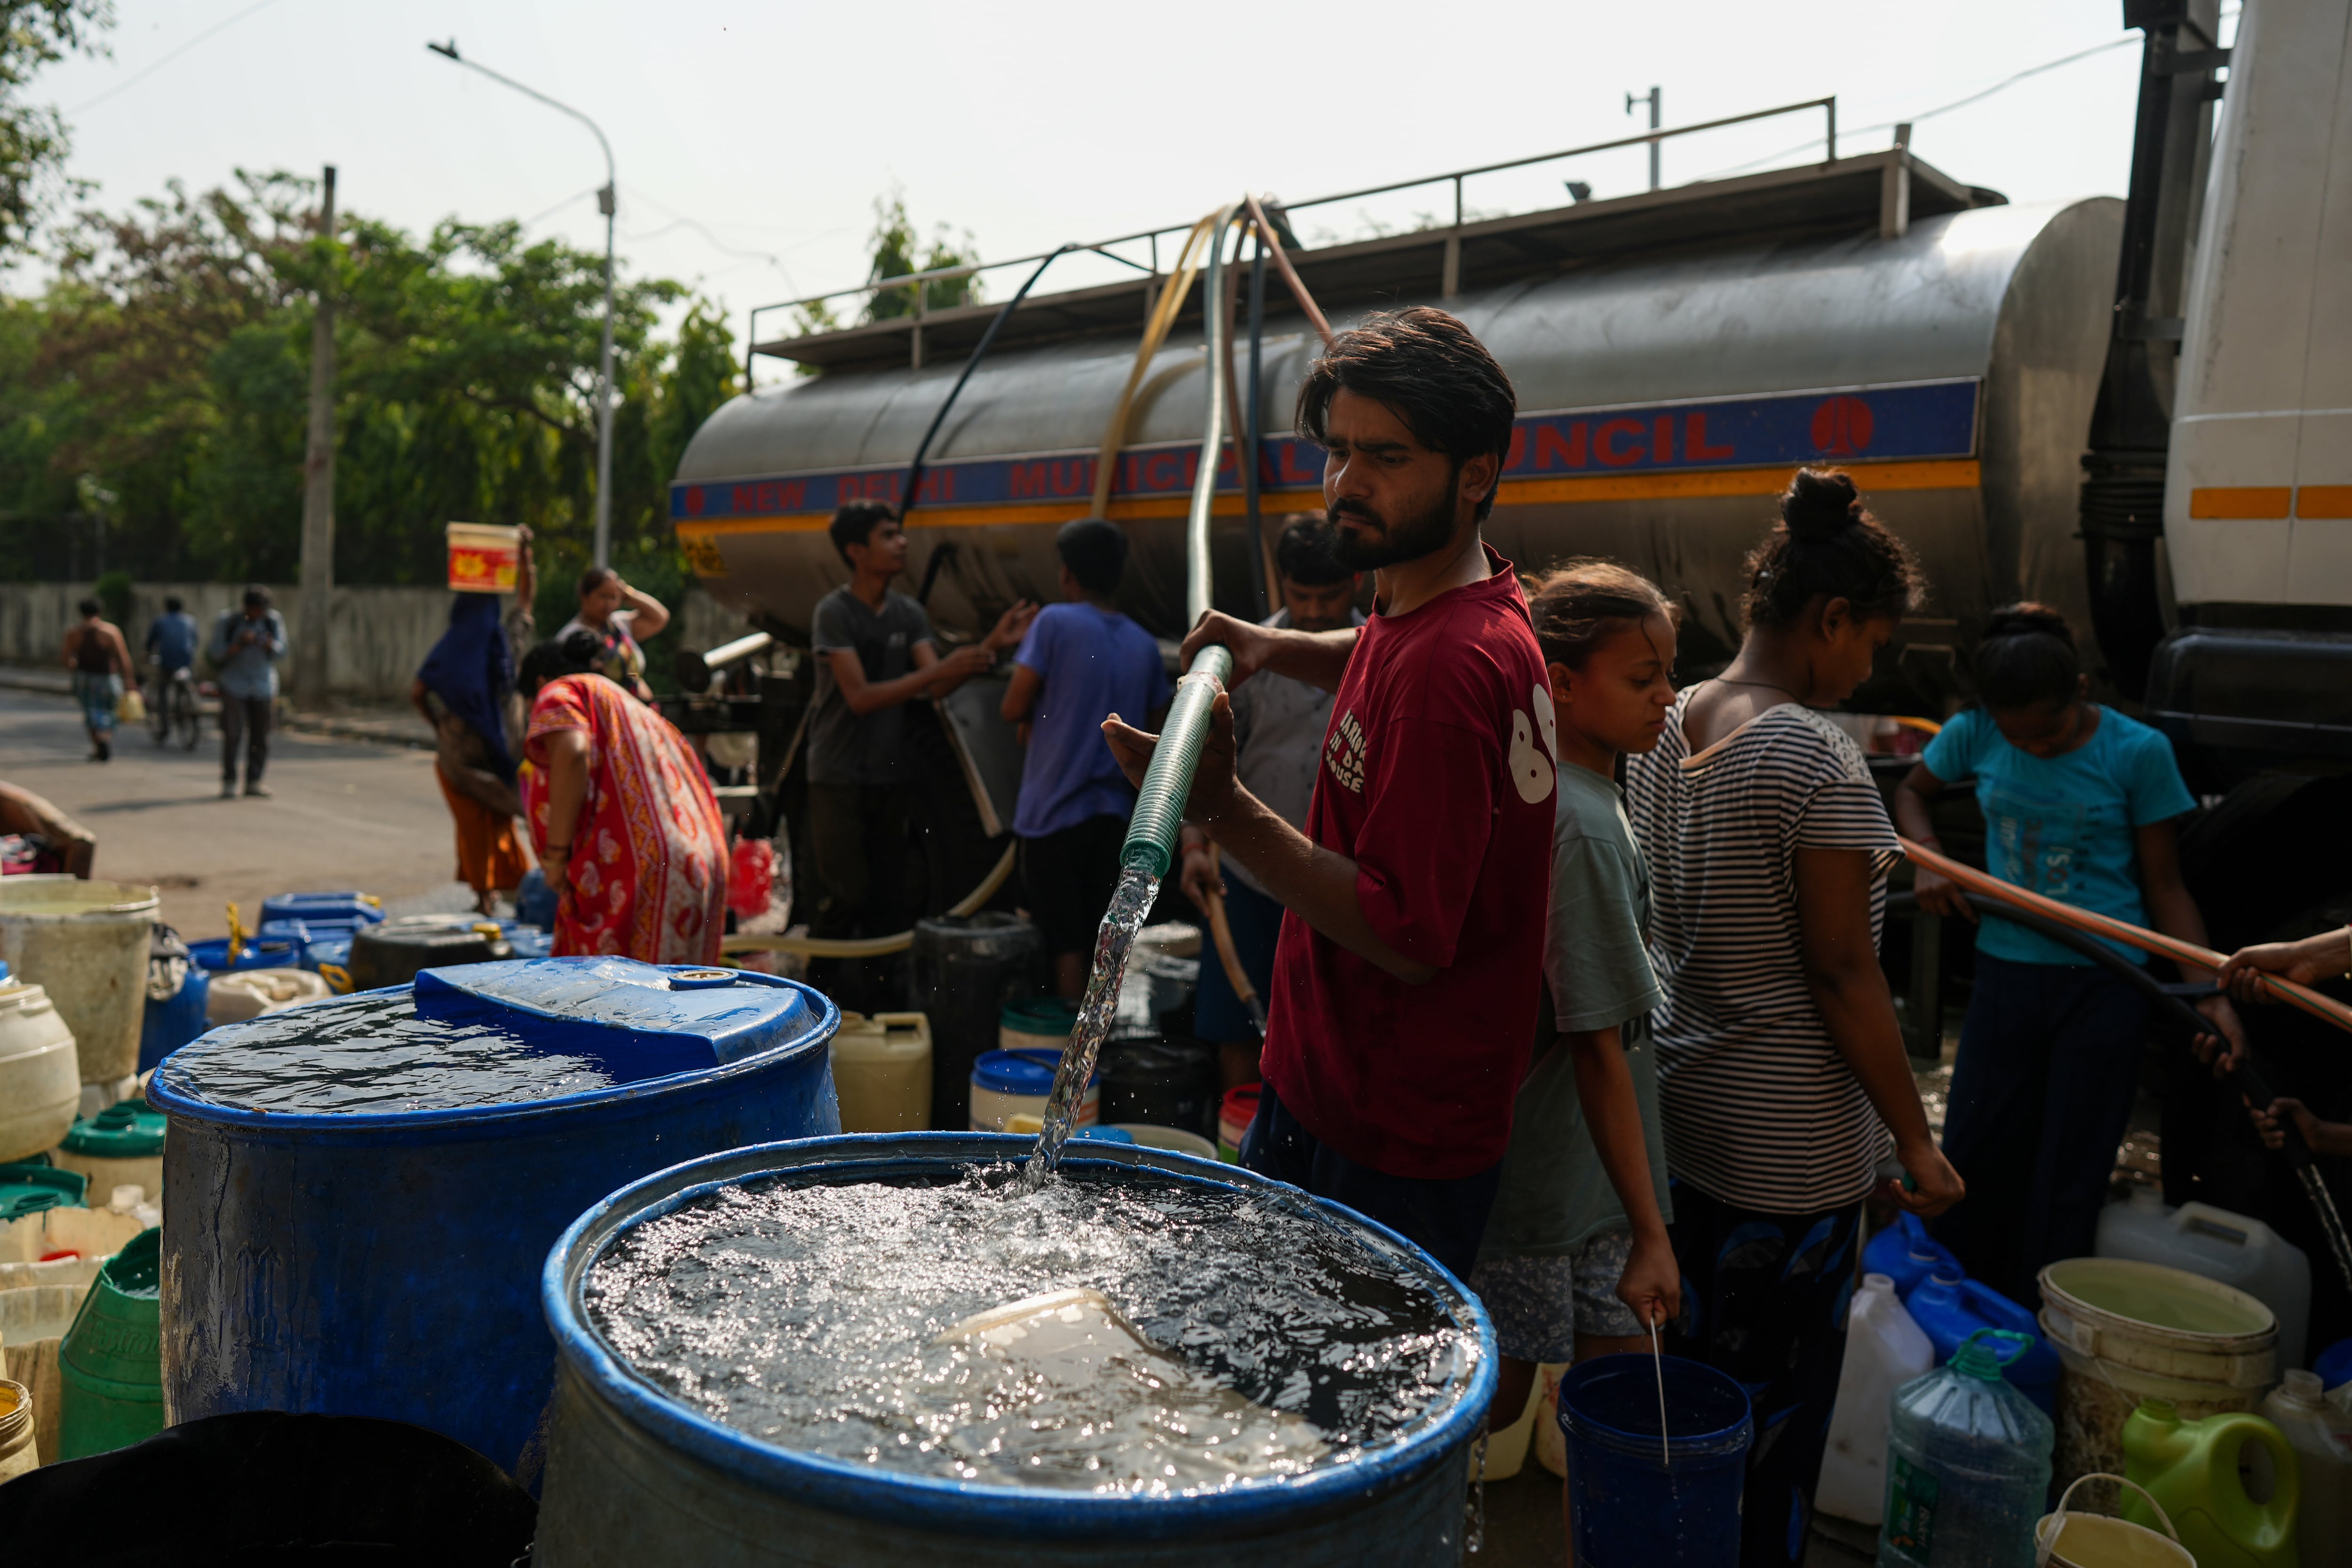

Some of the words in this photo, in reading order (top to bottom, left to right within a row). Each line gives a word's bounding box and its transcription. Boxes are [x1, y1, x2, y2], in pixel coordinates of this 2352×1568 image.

[732, 480, 807, 513] NEW
[837, 469, 955, 502] DELHI
[1326, 749, 1364, 794] HOUSE
